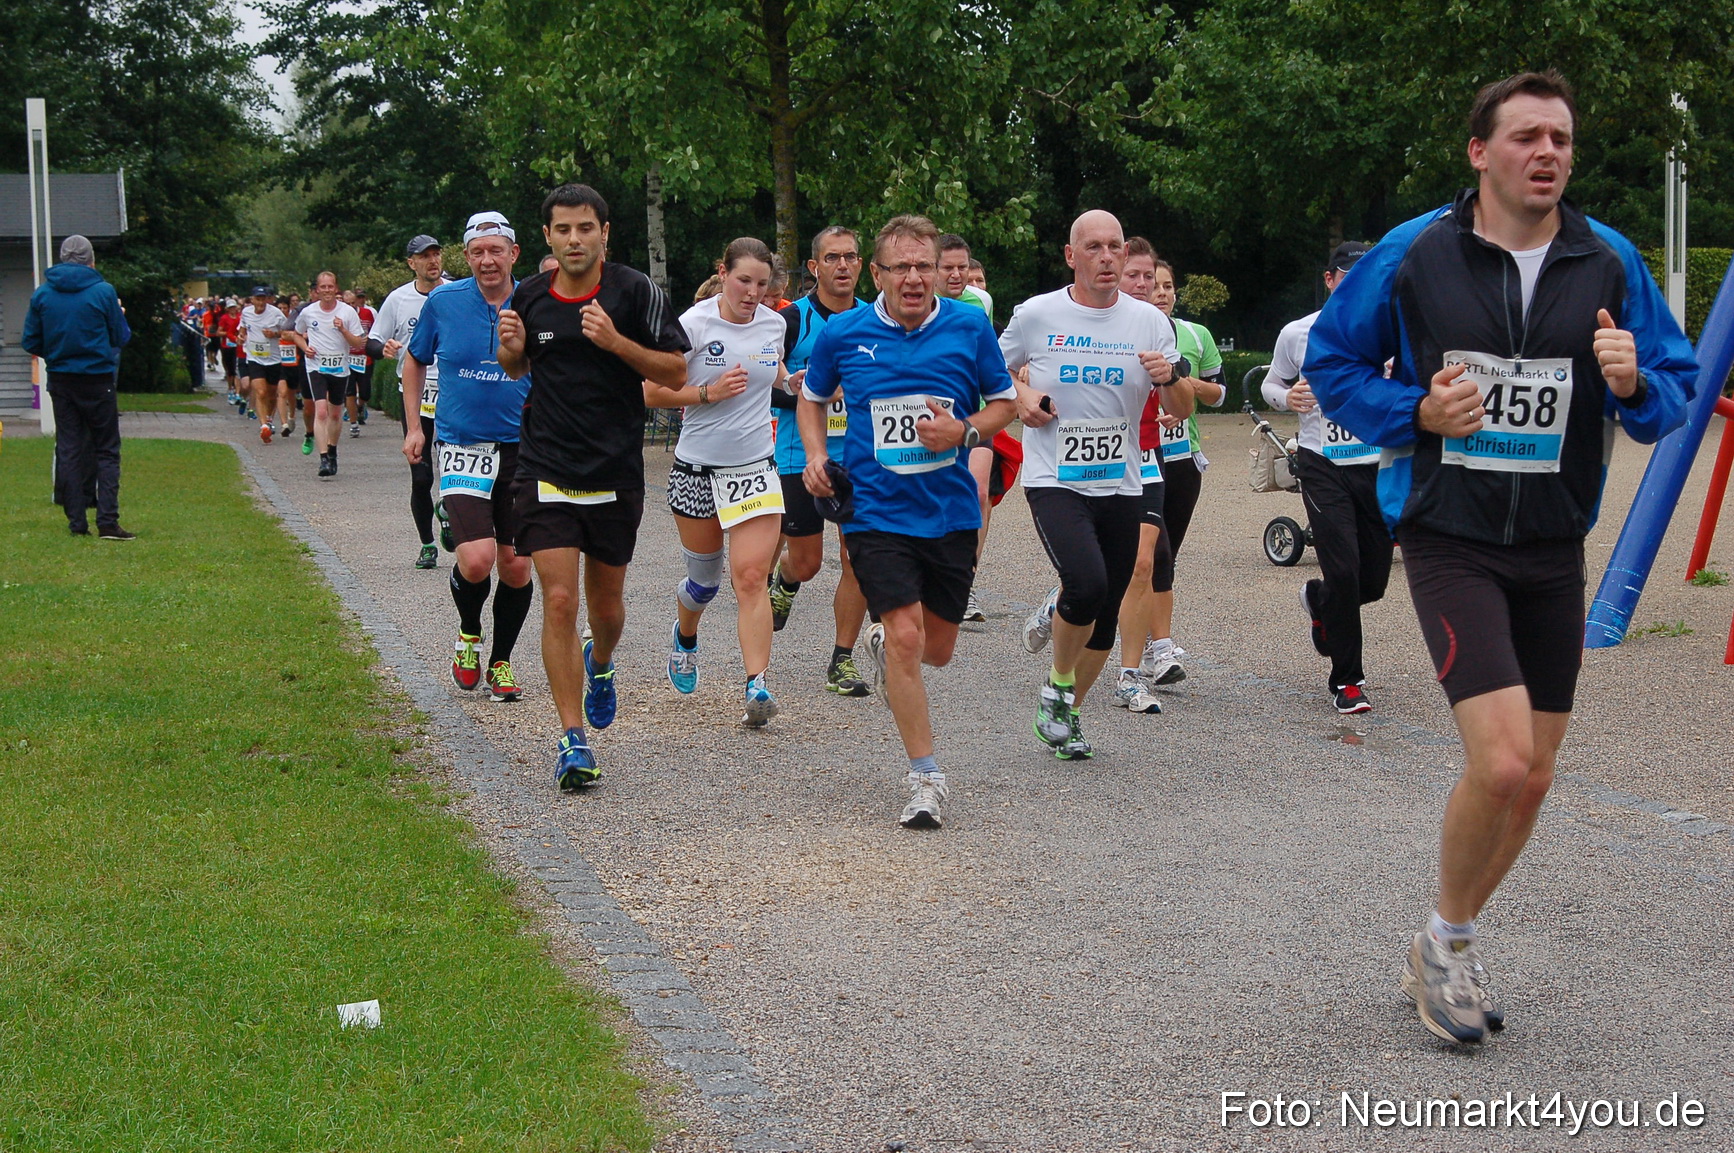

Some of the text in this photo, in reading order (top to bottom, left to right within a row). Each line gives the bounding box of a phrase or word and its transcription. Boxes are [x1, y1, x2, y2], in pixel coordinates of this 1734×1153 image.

[254, 344, 265, 352] 85
[1047, 334, 1135, 350] TEAM oberpfalz
[280, 348, 295, 357] 783
[321, 356, 343, 367] 2167
[705, 356, 726, 364] PARTL
[1490, 366, 1549, 380] Neumarkt
[421, 389, 439, 403] 47
[872, 403, 901, 413] PARTL
[1458, 380, 1559, 428] 458
[1058, 424, 1119, 434] PARTL Neumarkt
[1064, 433, 1123, 463] 2552
[1463, 434, 1537, 456] Christian
[443, 450, 493, 476] 2578
[897, 450, 937, 464] Johann
[735, 467, 765, 479] Neumarkt
[1081, 467, 1107, 480] Josef
[447, 477, 480, 489] Andreas
[726, 474, 768, 504] 223
[740, 499, 762, 513] Nora
